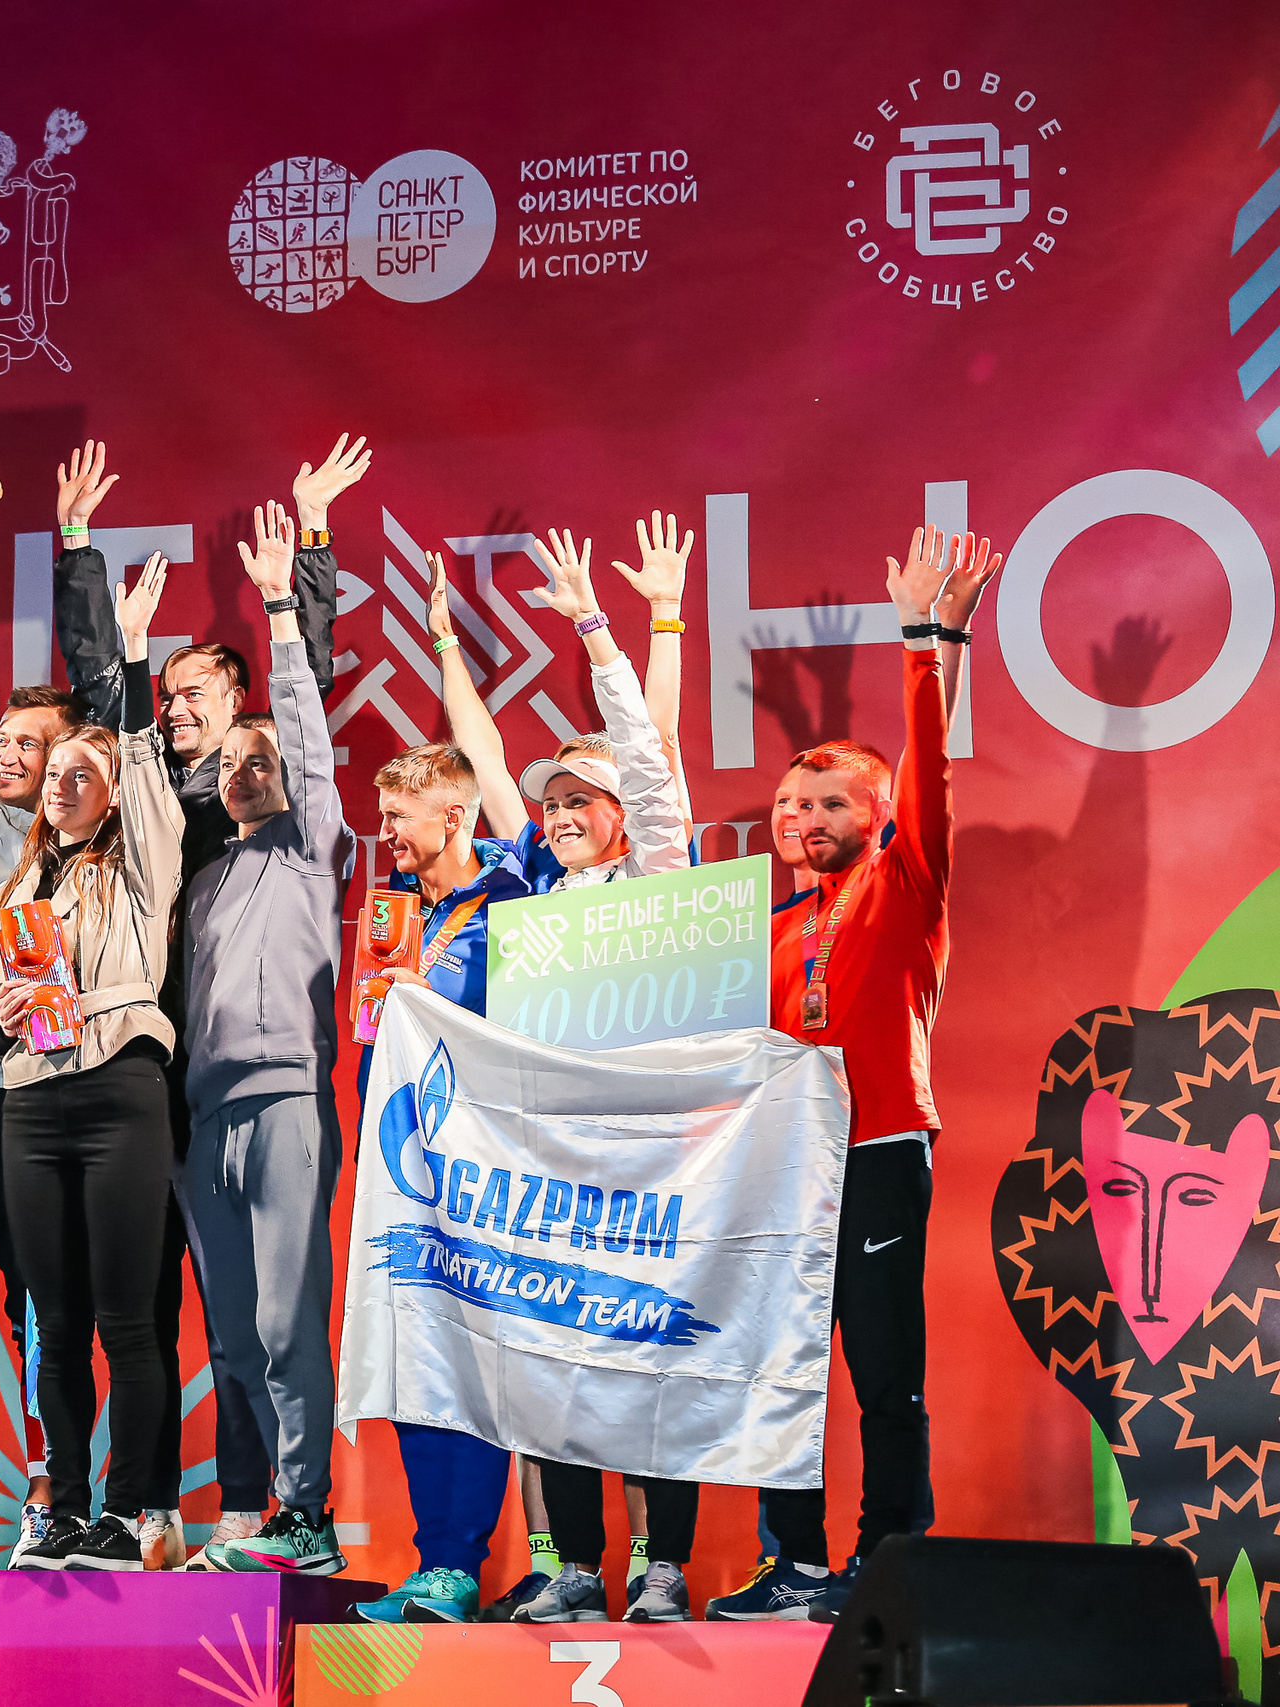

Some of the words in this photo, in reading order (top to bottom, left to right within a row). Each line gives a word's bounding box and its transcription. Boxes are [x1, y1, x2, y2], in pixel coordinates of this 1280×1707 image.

[853, 69, 1062, 151] БЕГОВОЕ
[520, 152, 642, 182] КОМИТЕТ
[649, 149, 689, 174] ПО
[379, 175, 465, 208] САНКТ
[518, 175, 699, 213] ФИЗИЧЕСКОЙ
[377, 209, 465, 243] ПЕТЕР
[518, 218, 641, 247] КУЛЬТУРЕ
[376, 244, 448, 276] БУРГ
[519, 257, 536, 280] И
[544, 249, 649, 278] СПОРТУ
[845, 206, 1068, 310] СООБЩЕСТВО
[372, 900, 390, 924] 3
[583, 894, 666, 936] БЕЛЫЕ
[673, 877, 756, 920] НОЧИ
[580, 911, 756, 970] МАРАФОН
[585, 965, 698, 1041] 000
[447, 1157, 684, 1260] GAZPROM
[416, 1237, 576, 1306] TRIATHLON
[577, 1293, 671, 1333] TEAM
[549, 1640, 624, 1707] 3
